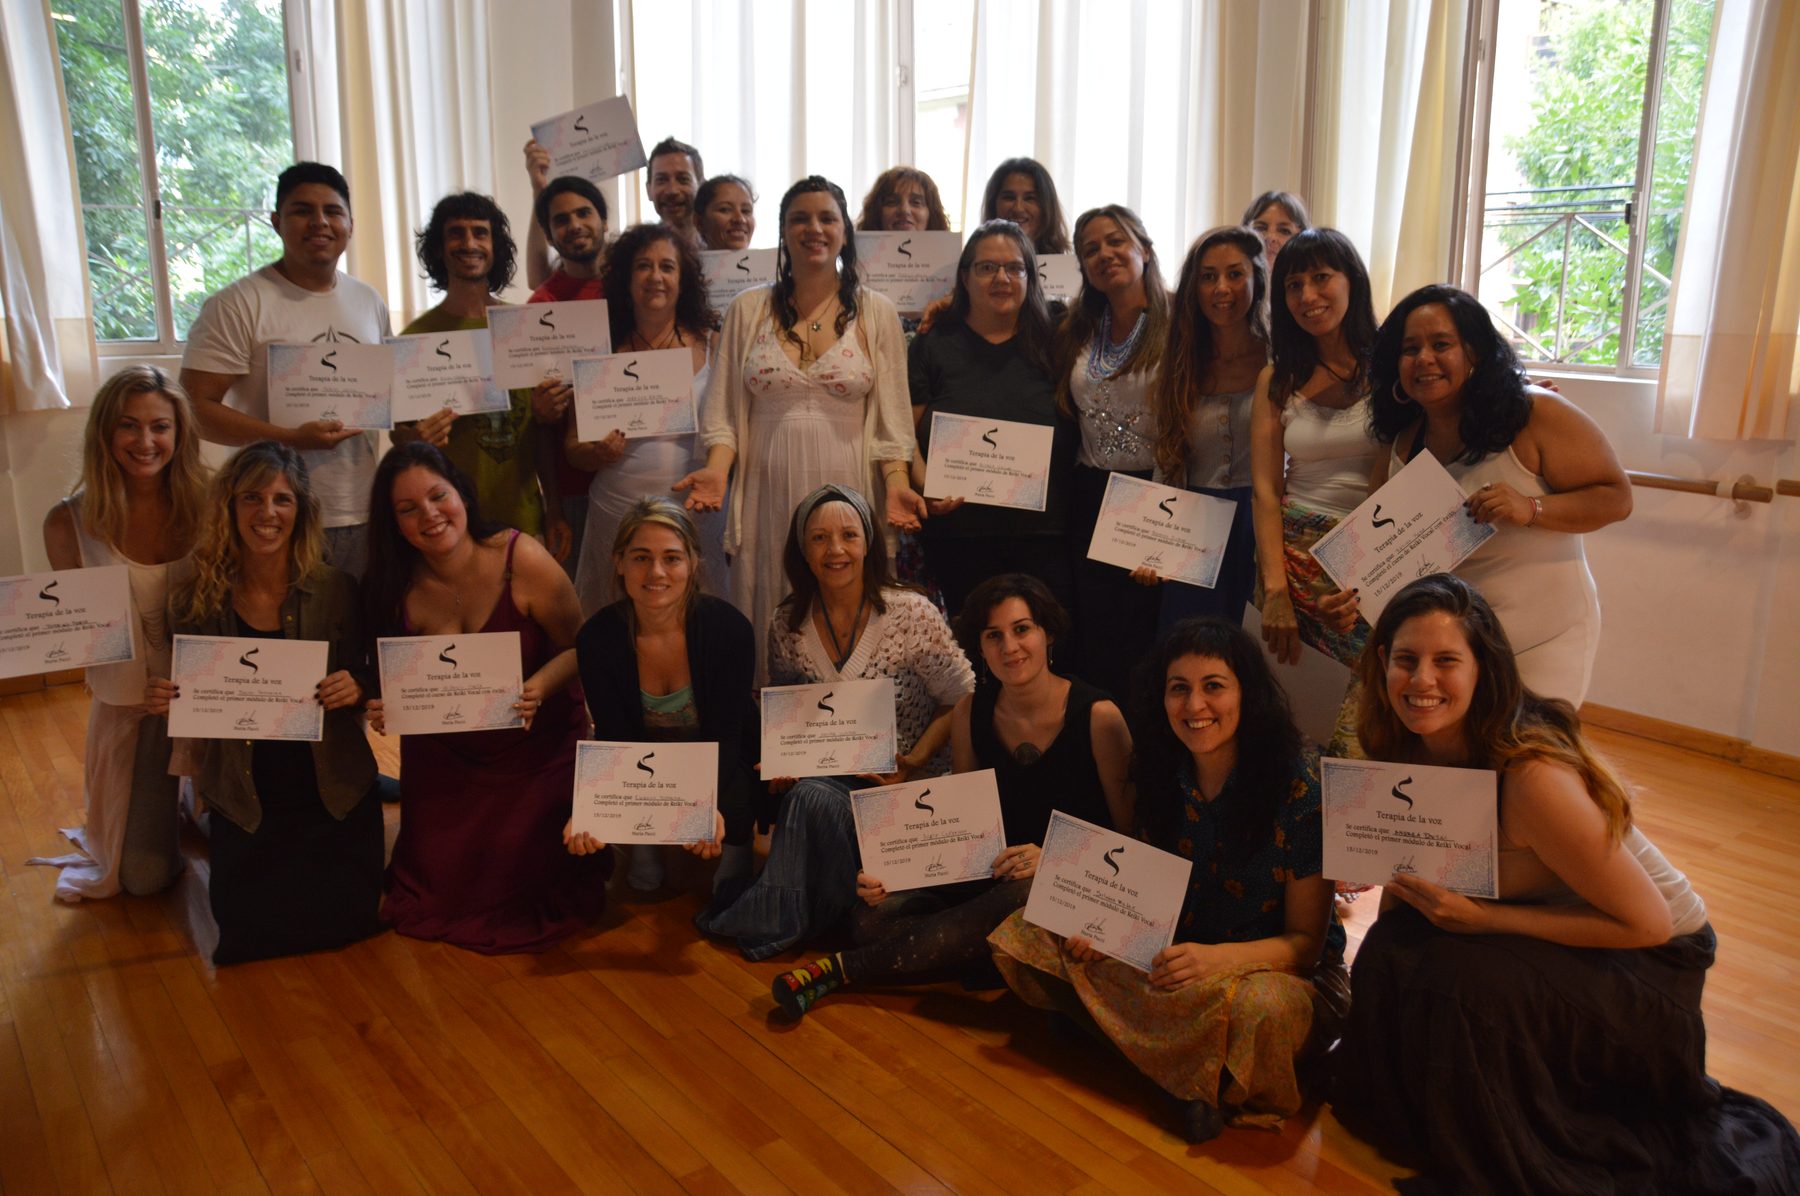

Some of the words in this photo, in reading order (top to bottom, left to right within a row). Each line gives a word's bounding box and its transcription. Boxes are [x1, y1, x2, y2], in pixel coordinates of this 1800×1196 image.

[1142, 516, 1164, 527] Terapia
[1374, 533, 1398, 554] Terapia
[1396, 526, 1406, 535] de
[1403, 520, 1413, 529] la
[1412, 511, 1424, 522] voz
[1373, 571, 1403, 598] 15/12/2019
[224, 677, 250, 685] Terapia
[1376, 811, 1405, 823] Terapia
[1407, 814, 1417, 822] de
[1419, 815, 1427, 823] la
[904, 822, 929, 830] Terapia
[1436, 840, 1452, 848] Reiki
[1454, 842, 1471, 850] Vocal
[1083, 870, 1108, 886] Terapia
[1109, 880, 1118, 889] de
[1118, 884, 1126, 893] la
[1126, 889, 1139, 898] voz
